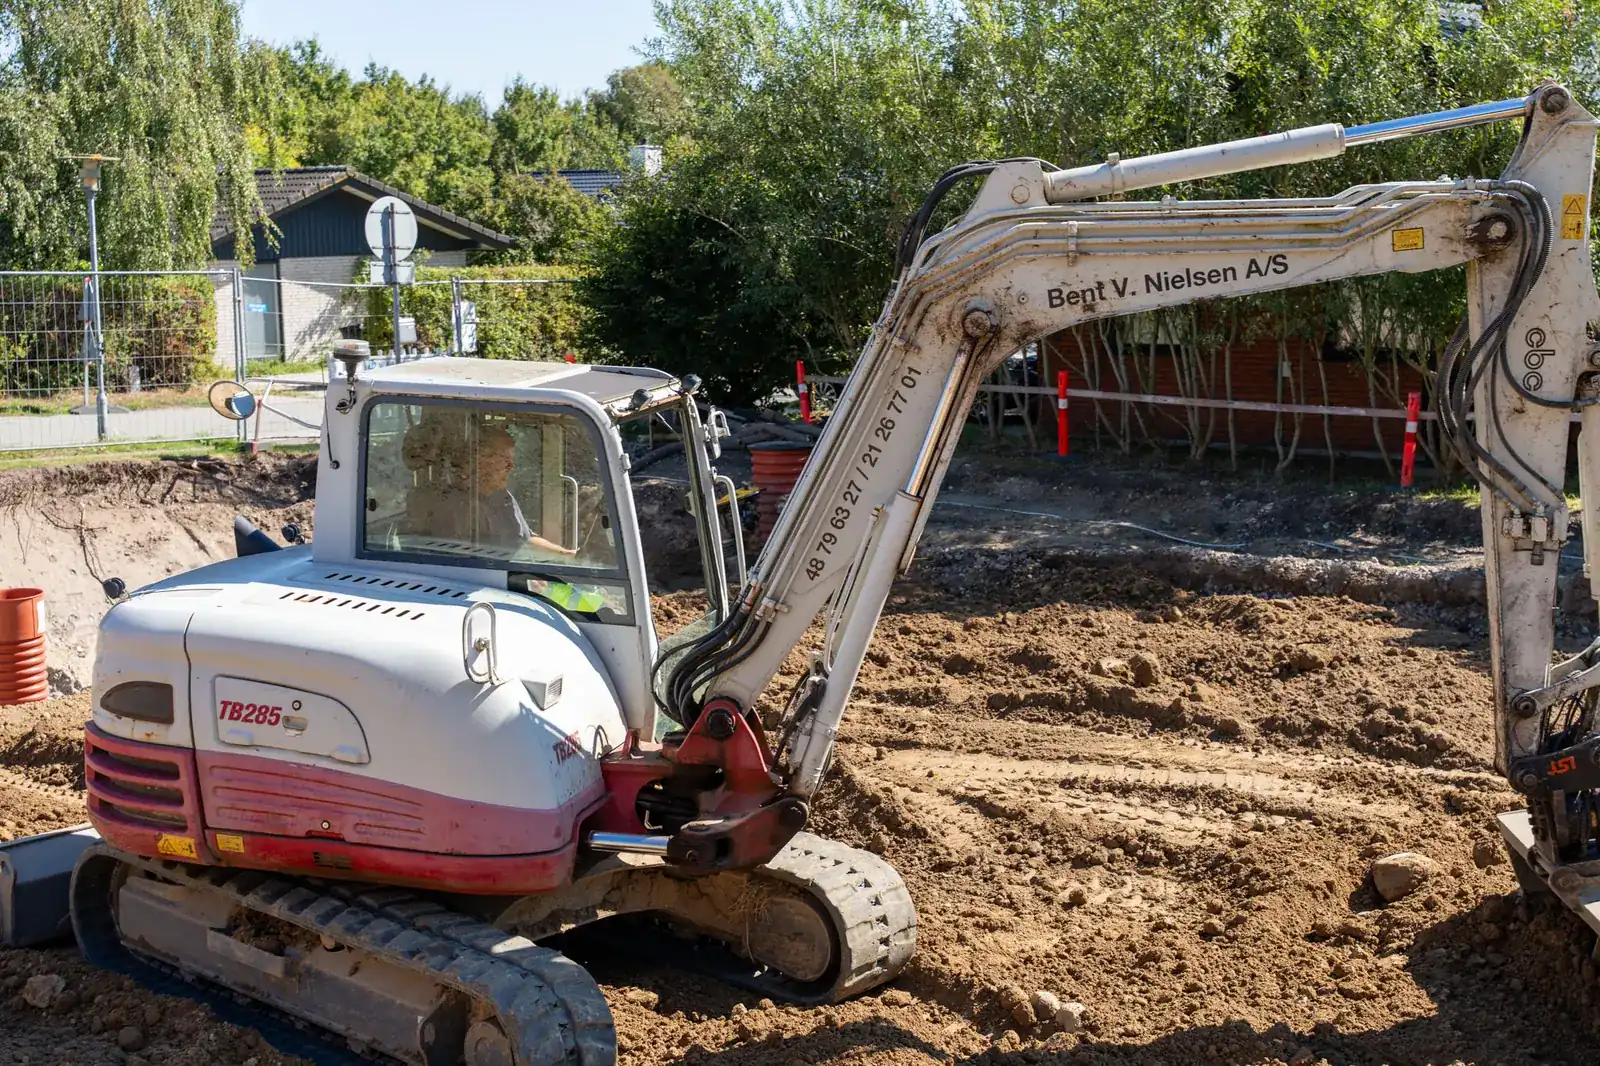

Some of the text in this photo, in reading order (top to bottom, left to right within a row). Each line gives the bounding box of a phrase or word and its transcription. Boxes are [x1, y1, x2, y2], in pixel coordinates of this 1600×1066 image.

[1047, 253, 1289, 309] Bent V. Nielsen A/S
[806, 366, 922, 581] 48 79 63 27 / 21 26 77 01
[219, 700, 283, 726] TB285
